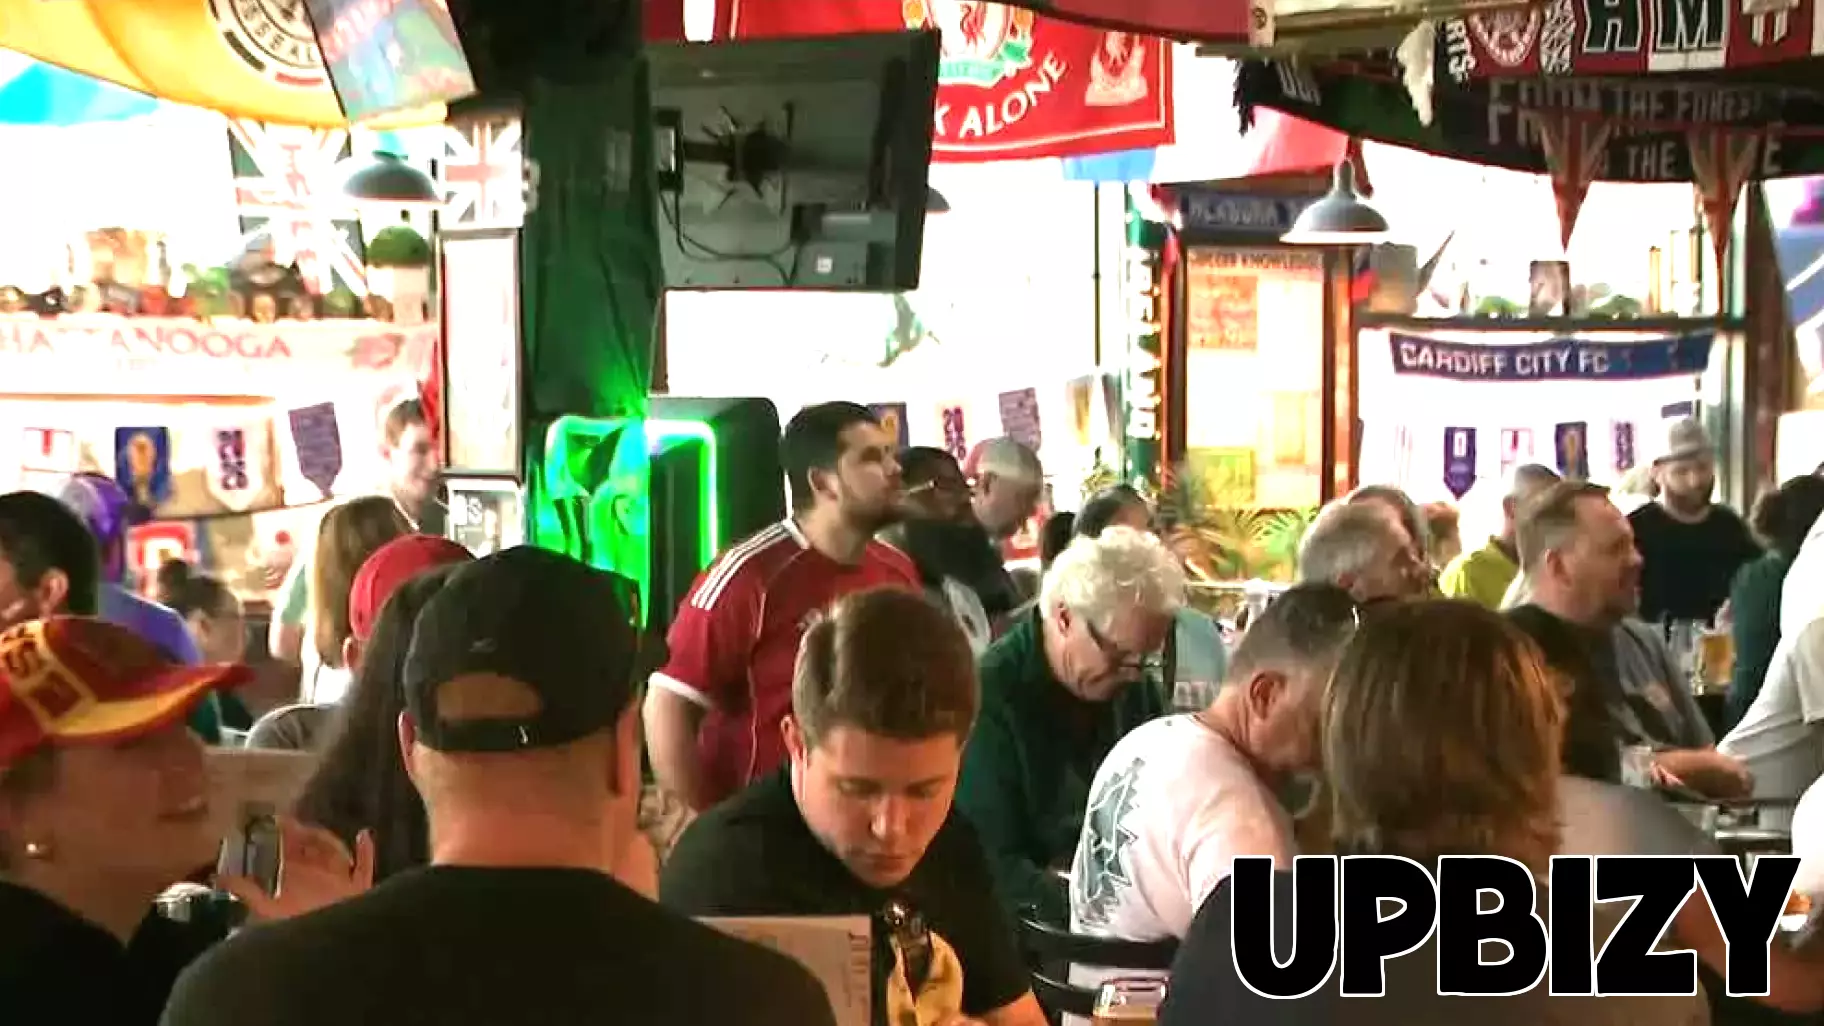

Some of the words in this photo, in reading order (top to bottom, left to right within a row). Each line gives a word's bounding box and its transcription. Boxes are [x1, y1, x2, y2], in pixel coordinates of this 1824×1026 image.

[959, 51, 1068, 138] ALONE
[1628, 141, 1677, 179] THE
[1400, 342, 1507, 375] CARDIFF
[1515, 345, 1573, 375] CITY
[1578, 350, 1610, 373] FC
